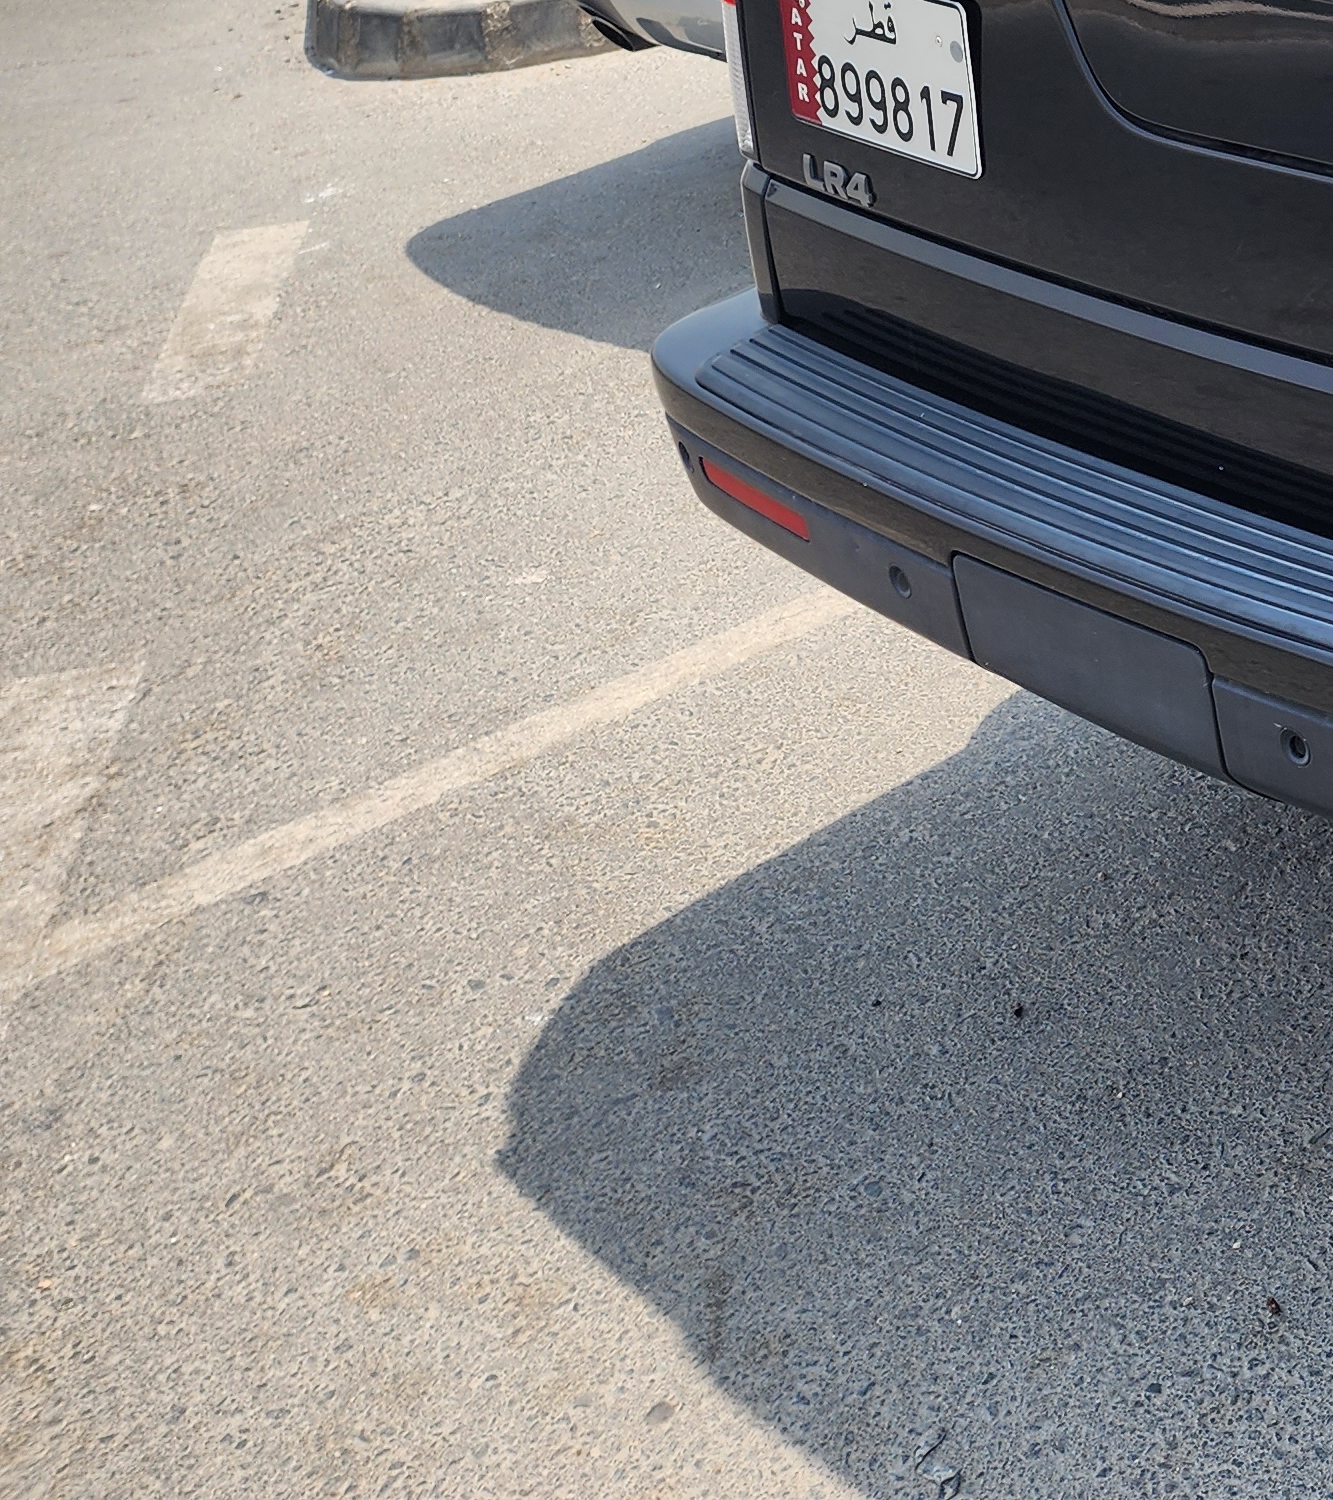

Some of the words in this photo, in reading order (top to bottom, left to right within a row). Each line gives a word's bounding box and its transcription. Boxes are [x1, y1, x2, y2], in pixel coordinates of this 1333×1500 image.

[843, 0, 897, 46] قطر
[817, 55, 964, 157] 899817
[803, 153, 876, 205] LR4
